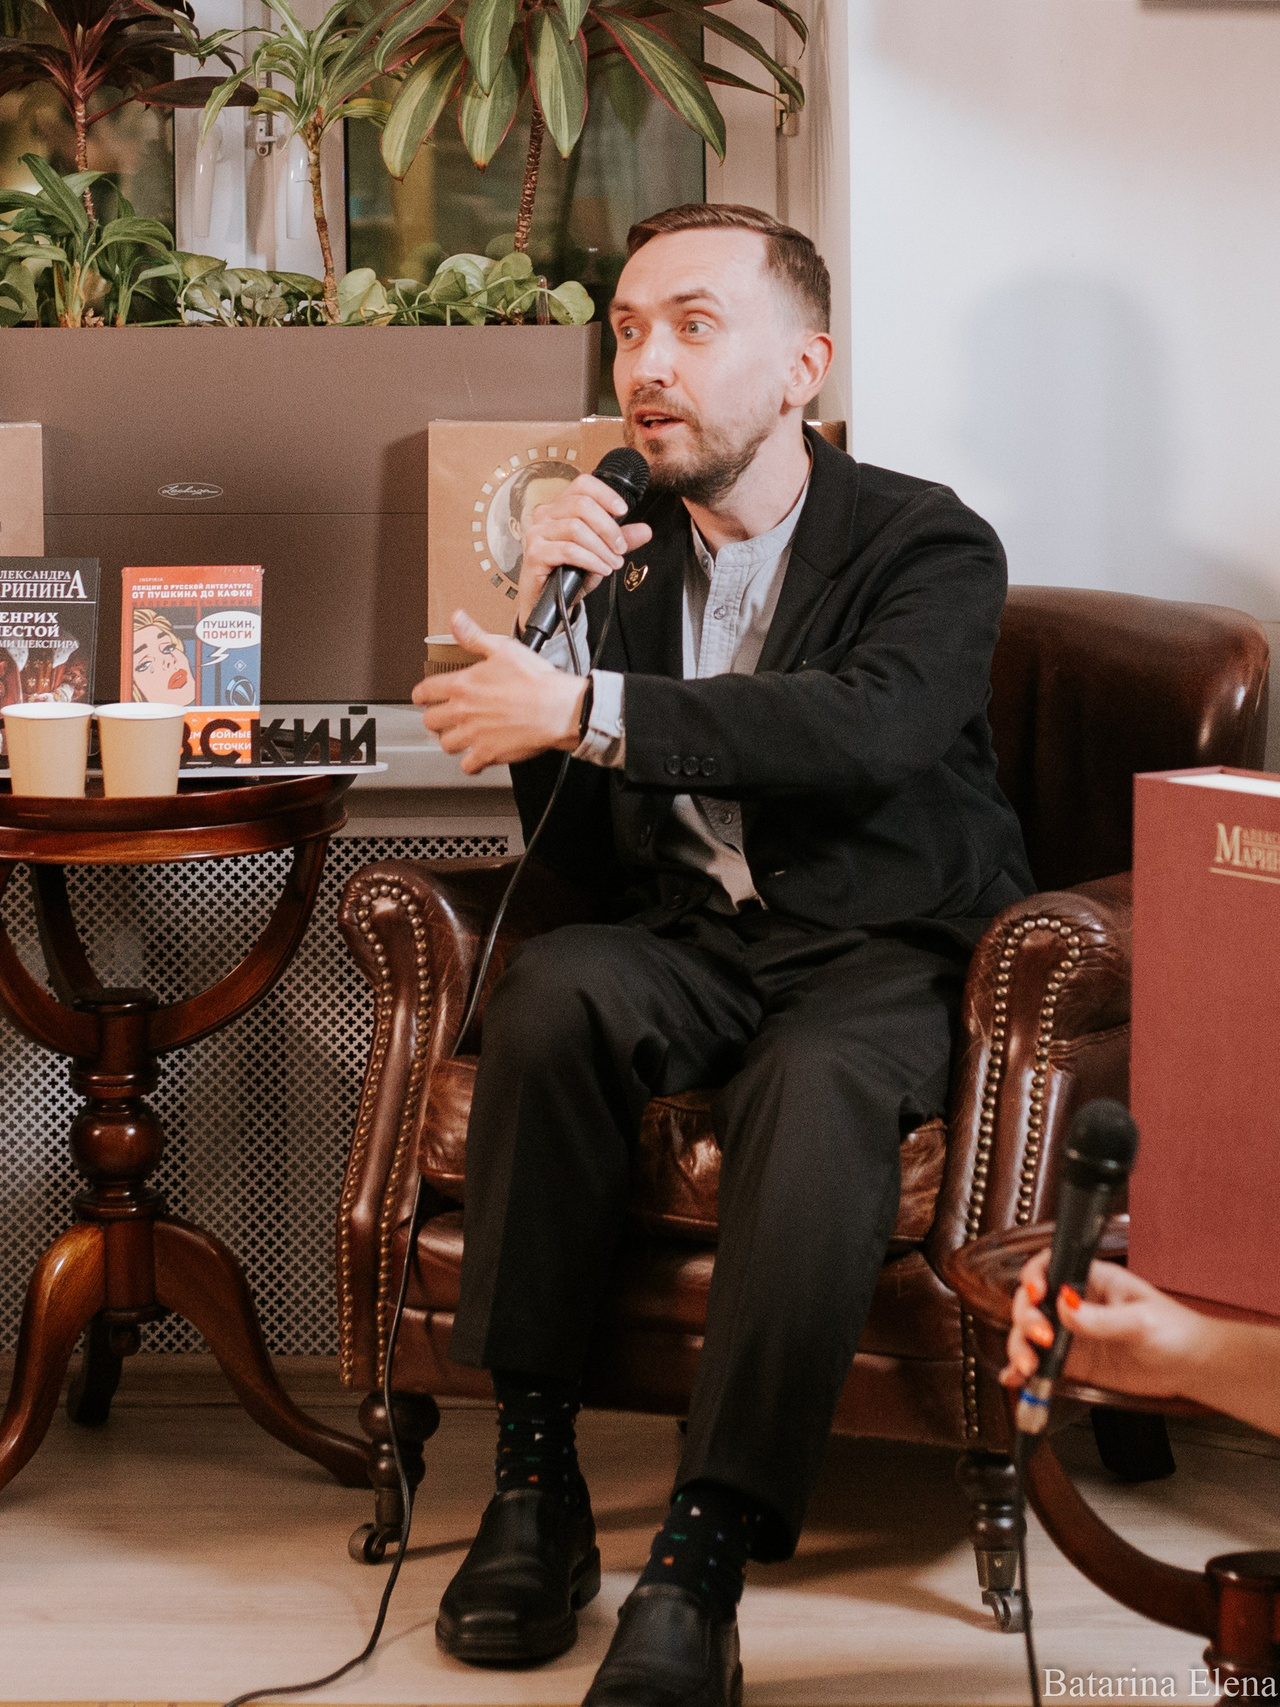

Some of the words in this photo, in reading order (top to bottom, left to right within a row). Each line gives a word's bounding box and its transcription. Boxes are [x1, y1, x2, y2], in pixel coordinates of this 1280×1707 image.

[170, 582, 204, 590] РУССКОЙ
[205, 582, 253, 590] ЛИТЕРАТУРЕ:
[132, 591, 145, 599] ОТ
[147, 590, 197, 599] ПУШКИНА
[200, 590, 215, 598] ДО
[203, 620, 256, 630] ПУШКИН,
[203, 630, 252, 639] ПОМОГИ
[17, 639, 80, 649] ШЕКСПИРА
